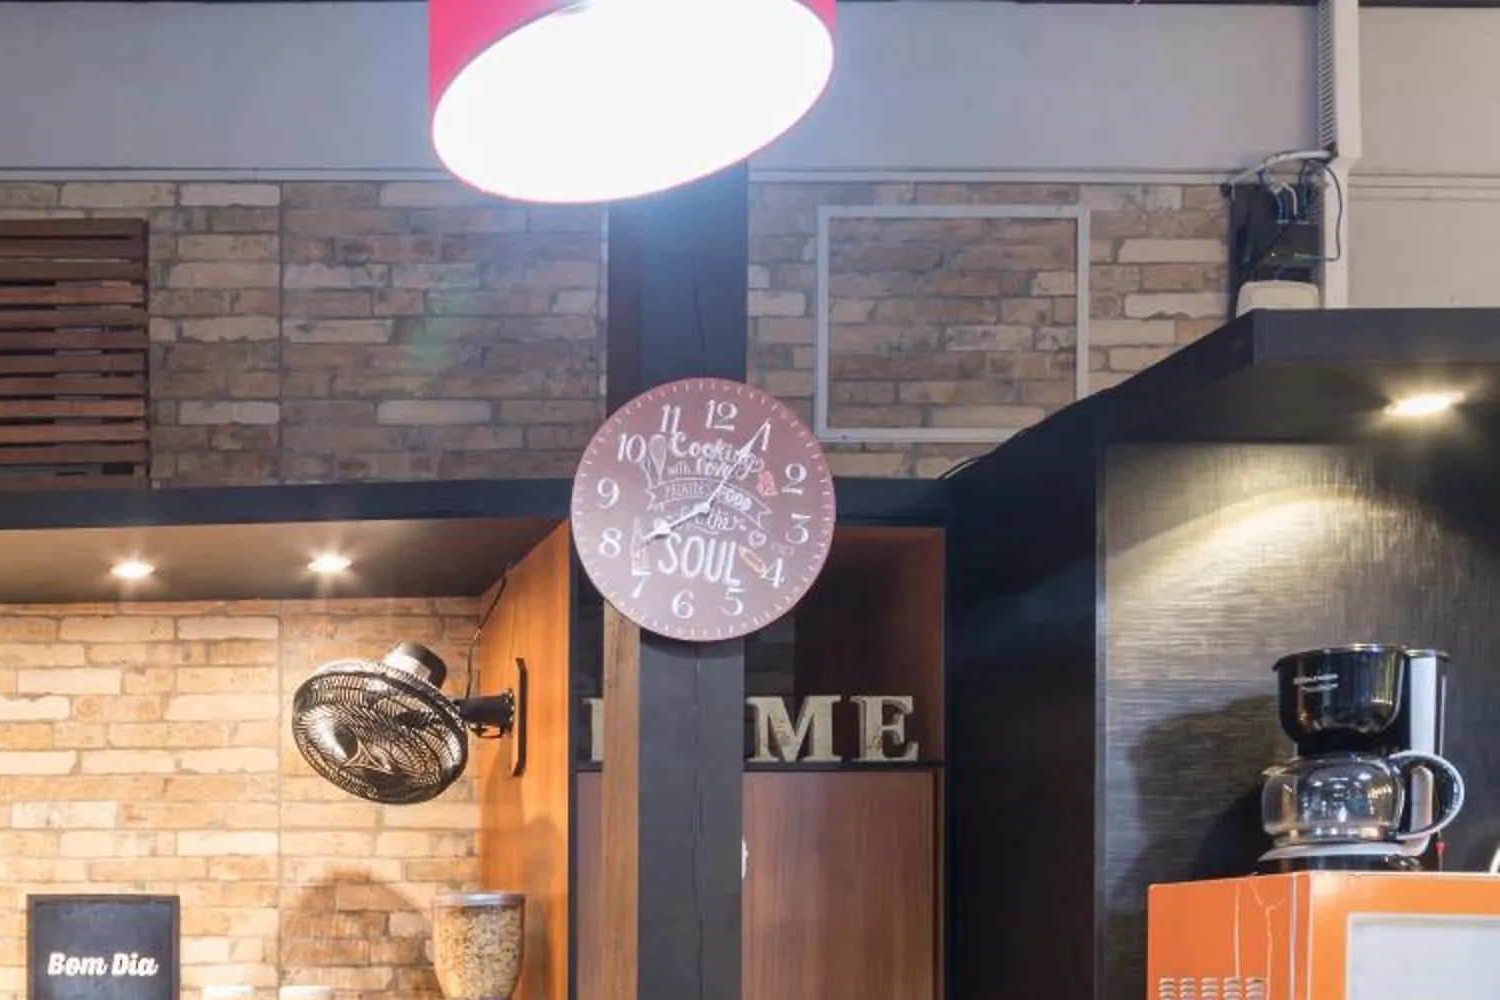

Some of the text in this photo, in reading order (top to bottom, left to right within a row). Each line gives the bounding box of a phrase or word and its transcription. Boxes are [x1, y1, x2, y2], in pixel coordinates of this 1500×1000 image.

[660, 404, 681, 434] 11
[705, 400, 738, 430] 12
[616, 433, 646, 463] 10
[597, 478, 620, 509] 9
[781, 463, 808, 495] 2
[600, 527, 622, 558] 8
[786, 513, 810, 545] 3
[657, 533, 741, 586] SOUL
[760, 557, 786, 588] 4
[671, 589, 695, 619] 6
[721, 587, 746, 616] 5
[47, 952, 159, 976] Bom Dia
